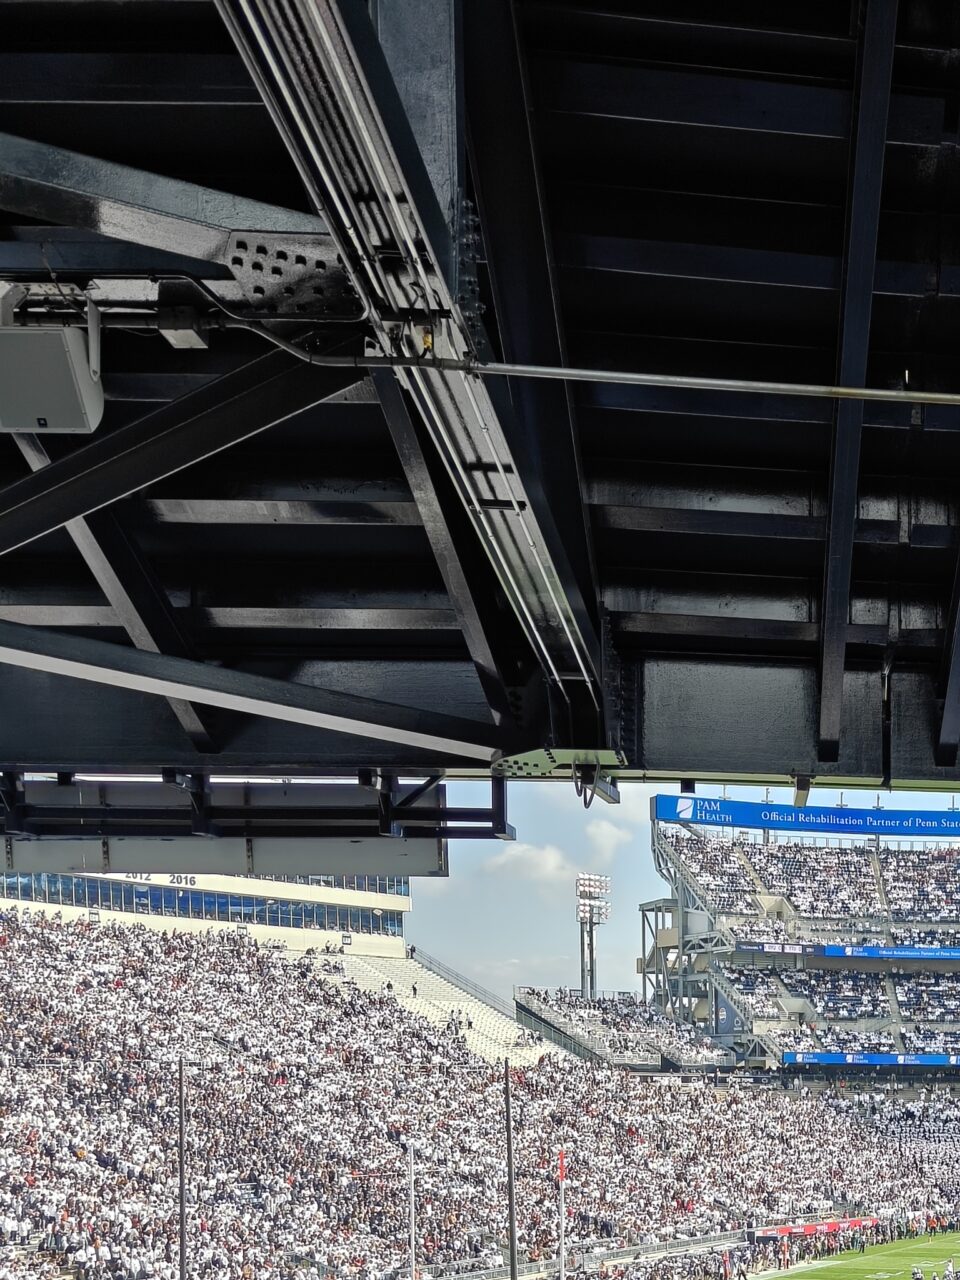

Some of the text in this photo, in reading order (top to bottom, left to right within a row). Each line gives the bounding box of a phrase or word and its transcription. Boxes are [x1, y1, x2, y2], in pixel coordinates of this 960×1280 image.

[696, 800, 720, 811] PAM
[761, 811, 795, 822] Official
[799, 812, 863, 826] Rehabilitation
[866, 816, 899, 827] Partner
[903, 818, 913, 827] of
[916, 818, 937, 828] Penn
[169, 874, 196, 886] 2016
